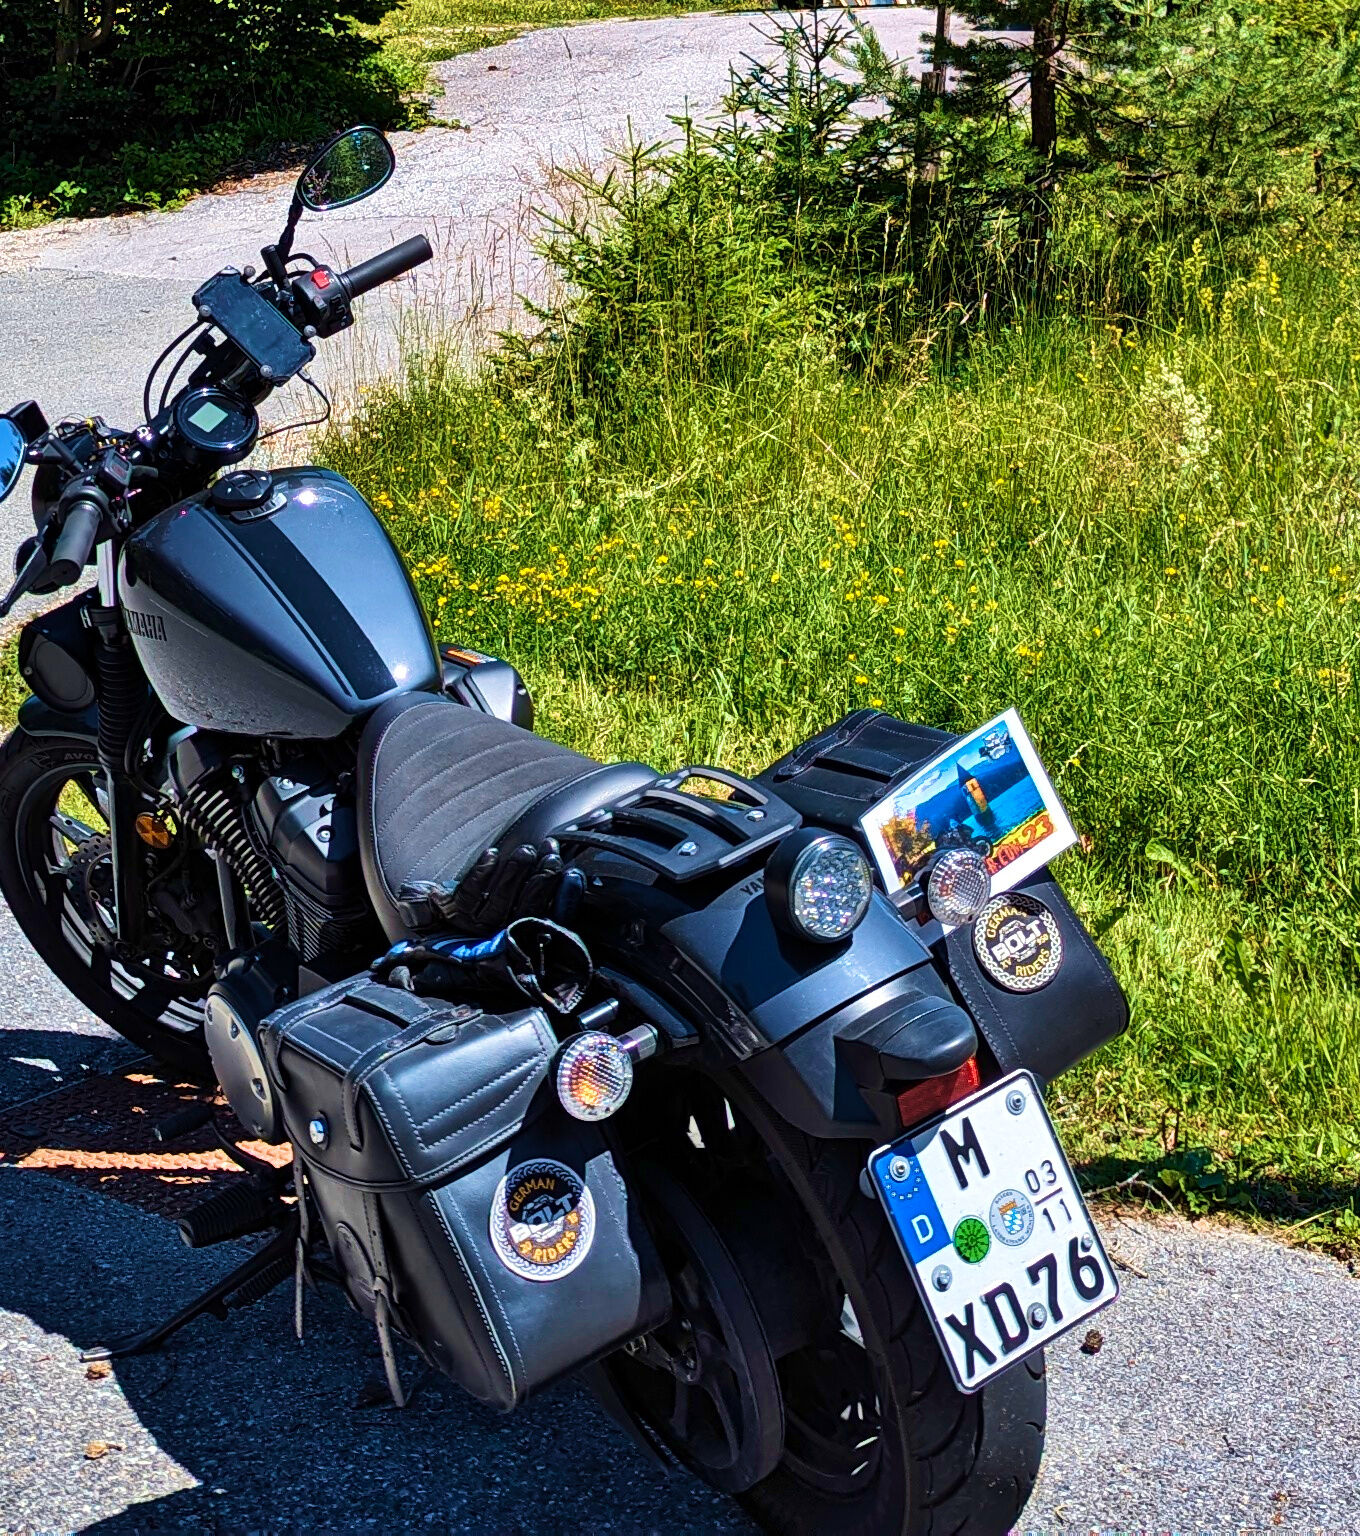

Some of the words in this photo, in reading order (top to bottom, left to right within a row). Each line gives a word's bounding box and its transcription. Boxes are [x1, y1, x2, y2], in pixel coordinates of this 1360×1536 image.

[991, 919, 1041, 962] BOLT
[1016, 948, 1051, 976] RIDERS
[939, 1117, 990, 1190] M
[1024, 1159, 1057, 1194] 03
[509, 1177, 556, 1212] GERMAN
[509, 1193, 573, 1243] BOLT
[911, 1213, 934, 1244] D
[533, 1230, 576, 1262] RIDERS
